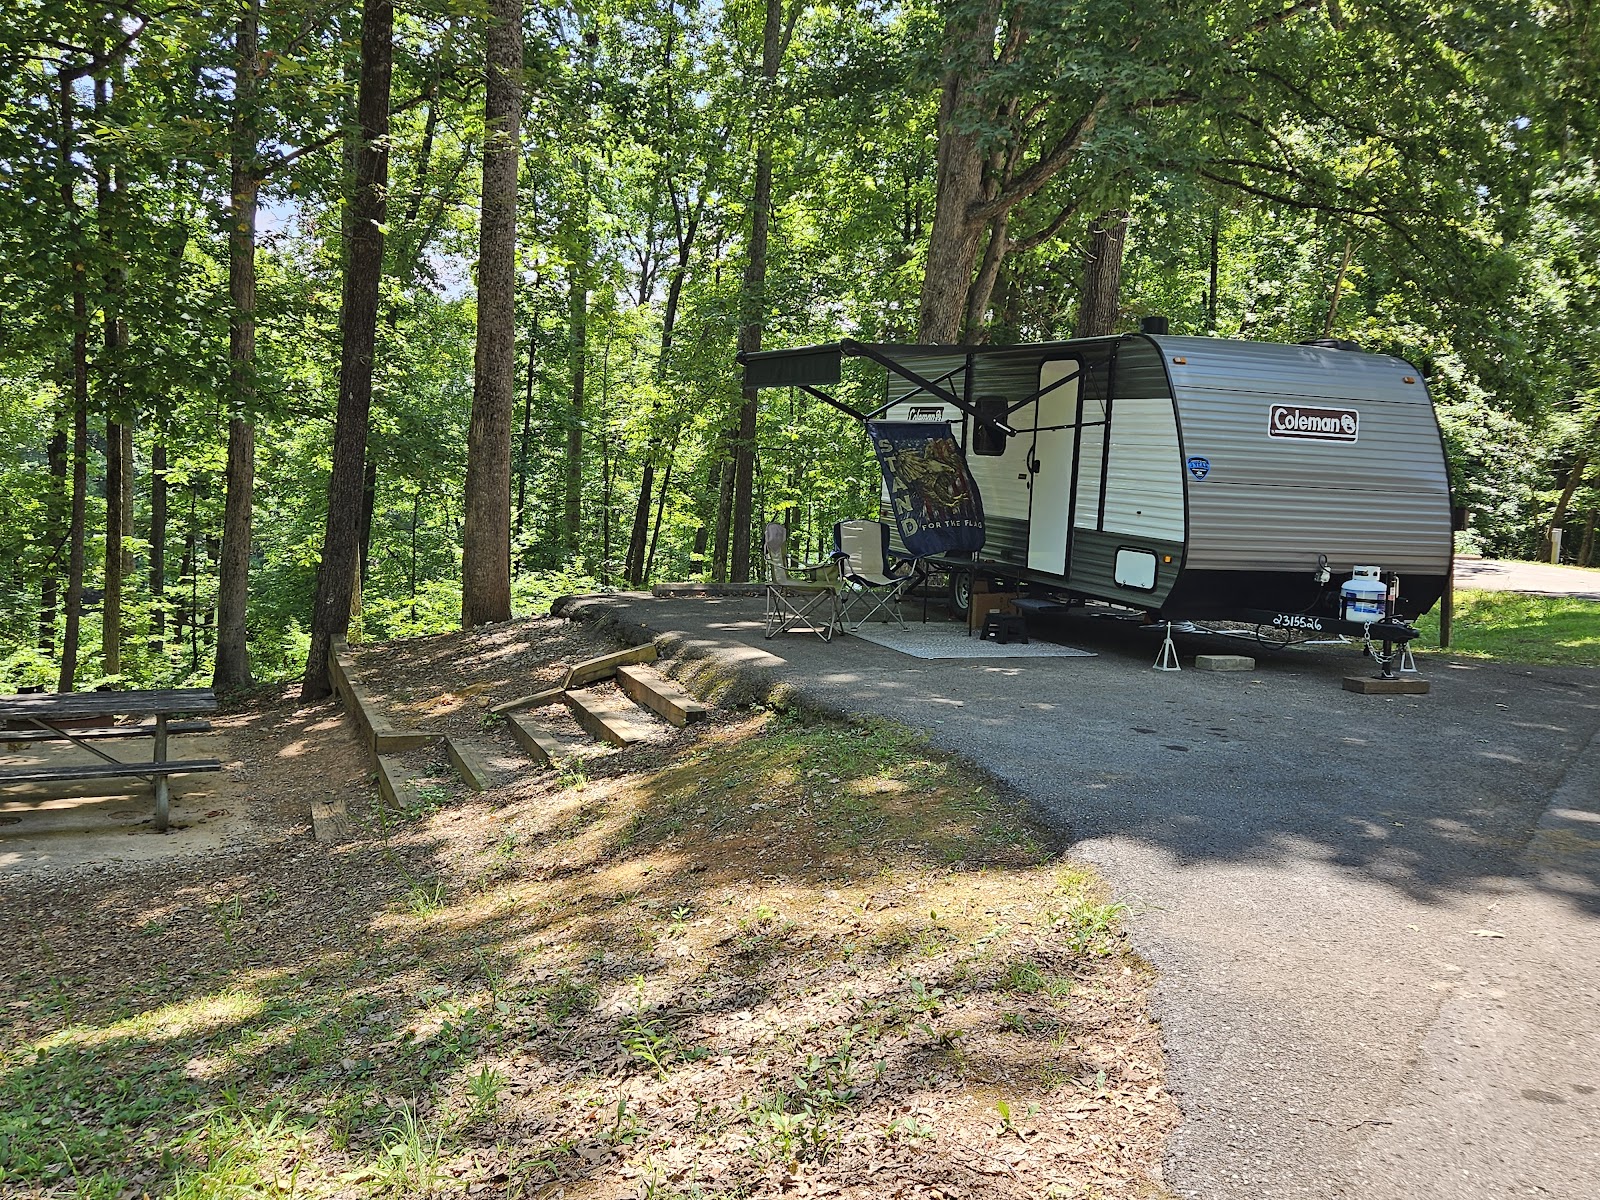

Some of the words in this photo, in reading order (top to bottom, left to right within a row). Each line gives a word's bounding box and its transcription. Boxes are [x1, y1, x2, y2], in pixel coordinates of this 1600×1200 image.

[1274, 408, 1340, 432] Coleman
[878, 439, 918, 538] STAND
[922, 522, 942, 531] FOR
[945, 520, 961, 528] THE
[964, 519, 983, 529] FLAG
[1273, 613, 1322, 631] 2315526
